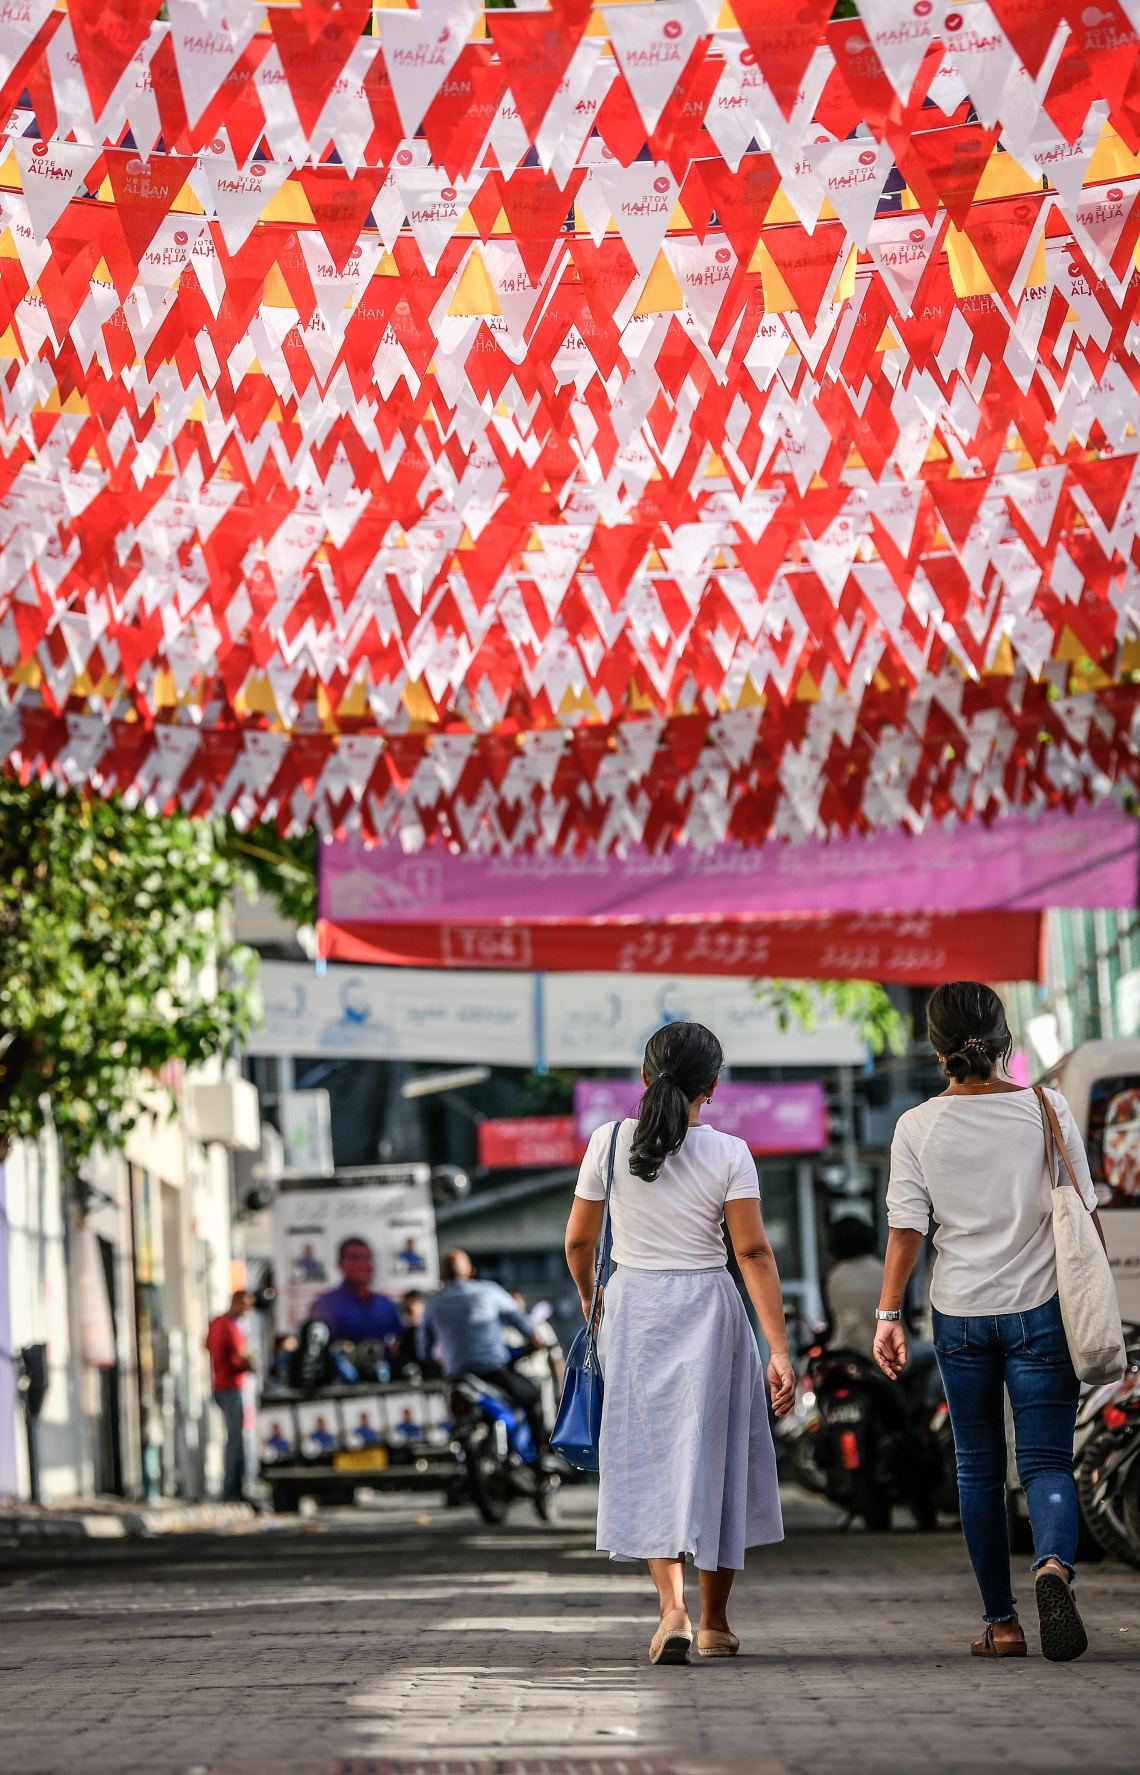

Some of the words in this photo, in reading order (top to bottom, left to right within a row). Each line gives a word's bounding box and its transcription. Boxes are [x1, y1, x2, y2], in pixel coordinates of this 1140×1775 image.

[948, 31, 977, 42] VOTE
[949, 35, 1002, 52] ALHAN
[32, 158, 56, 167] VOTE
[28, 165, 73, 178] ALHAN
[192, 246, 215, 256] ALH
[280, 259, 306, 270] ALH
[179, 281, 200, 290] ALH
[963, 294, 989, 302] VOTE
[961, 299, 998, 312] ALHA
[393, 323, 417, 333] ALH
